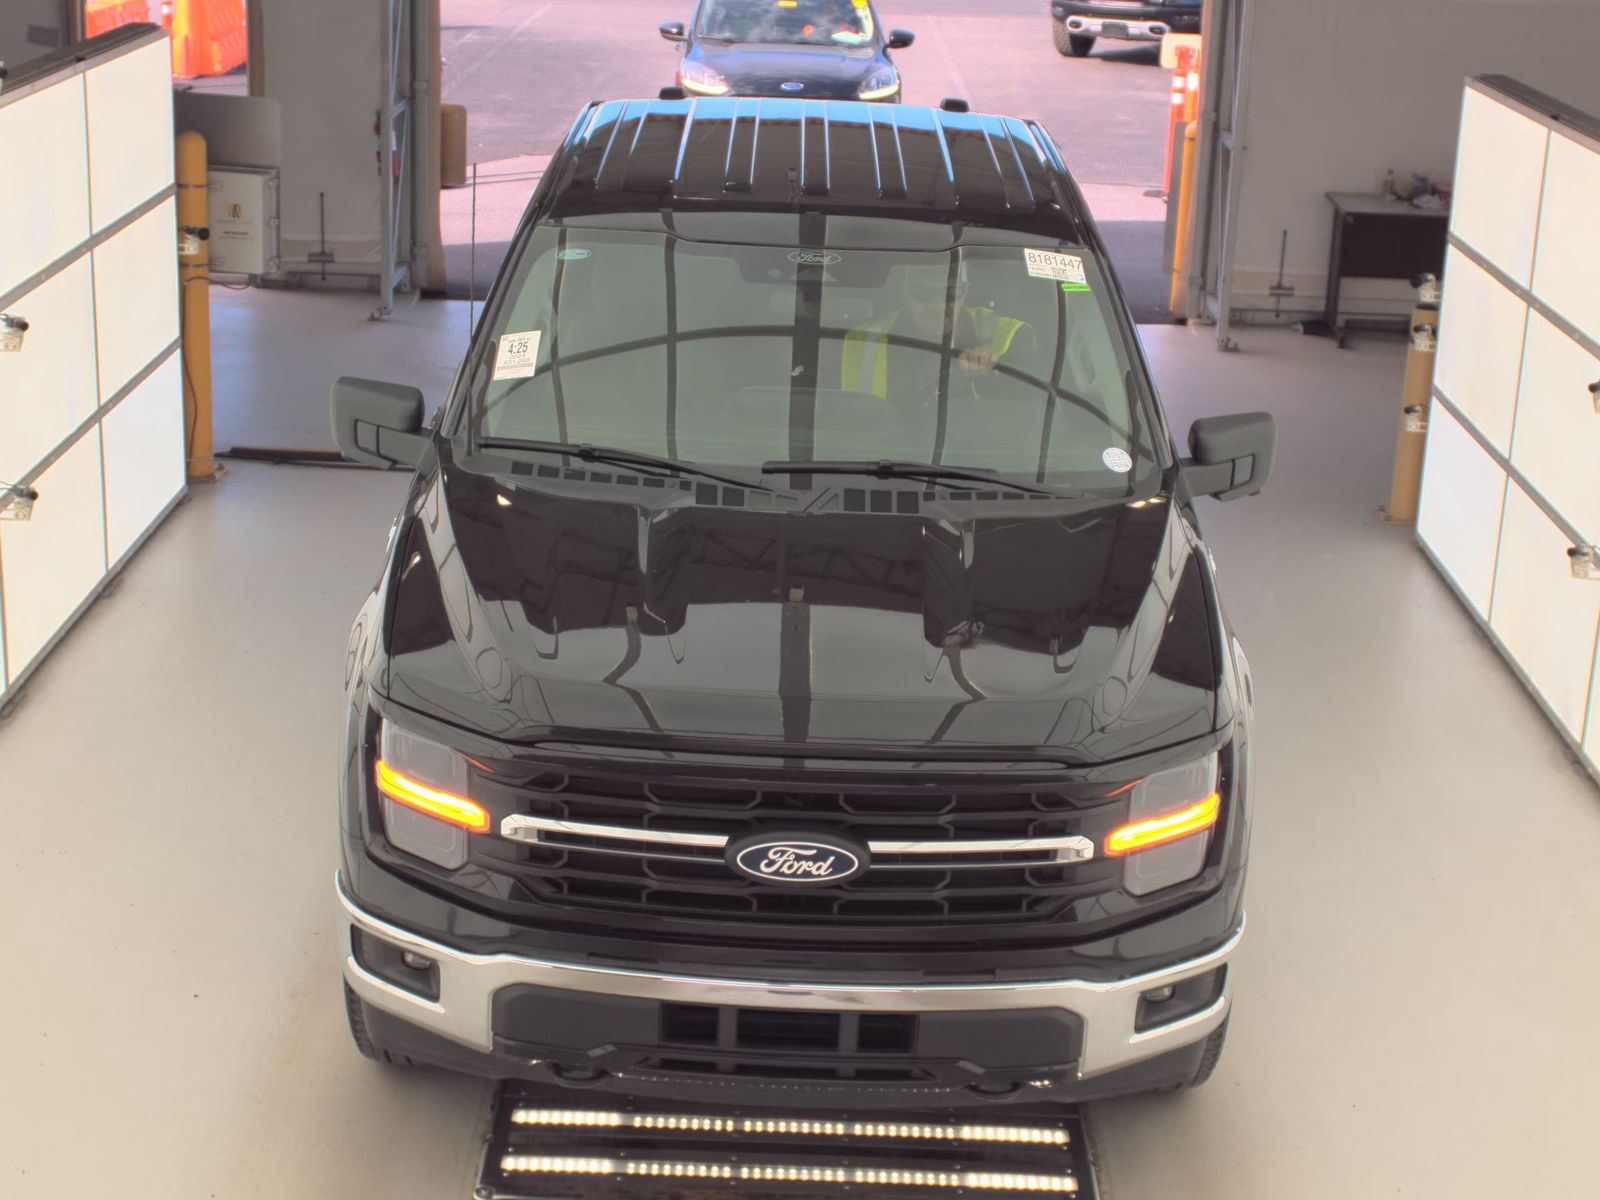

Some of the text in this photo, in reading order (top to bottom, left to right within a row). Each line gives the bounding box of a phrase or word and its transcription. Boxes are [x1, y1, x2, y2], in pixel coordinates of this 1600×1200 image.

[1028, 252, 1082, 270] 8181447
[507, 341, 529, 354] 4:25
[760, 846, 836, 876] Ford
